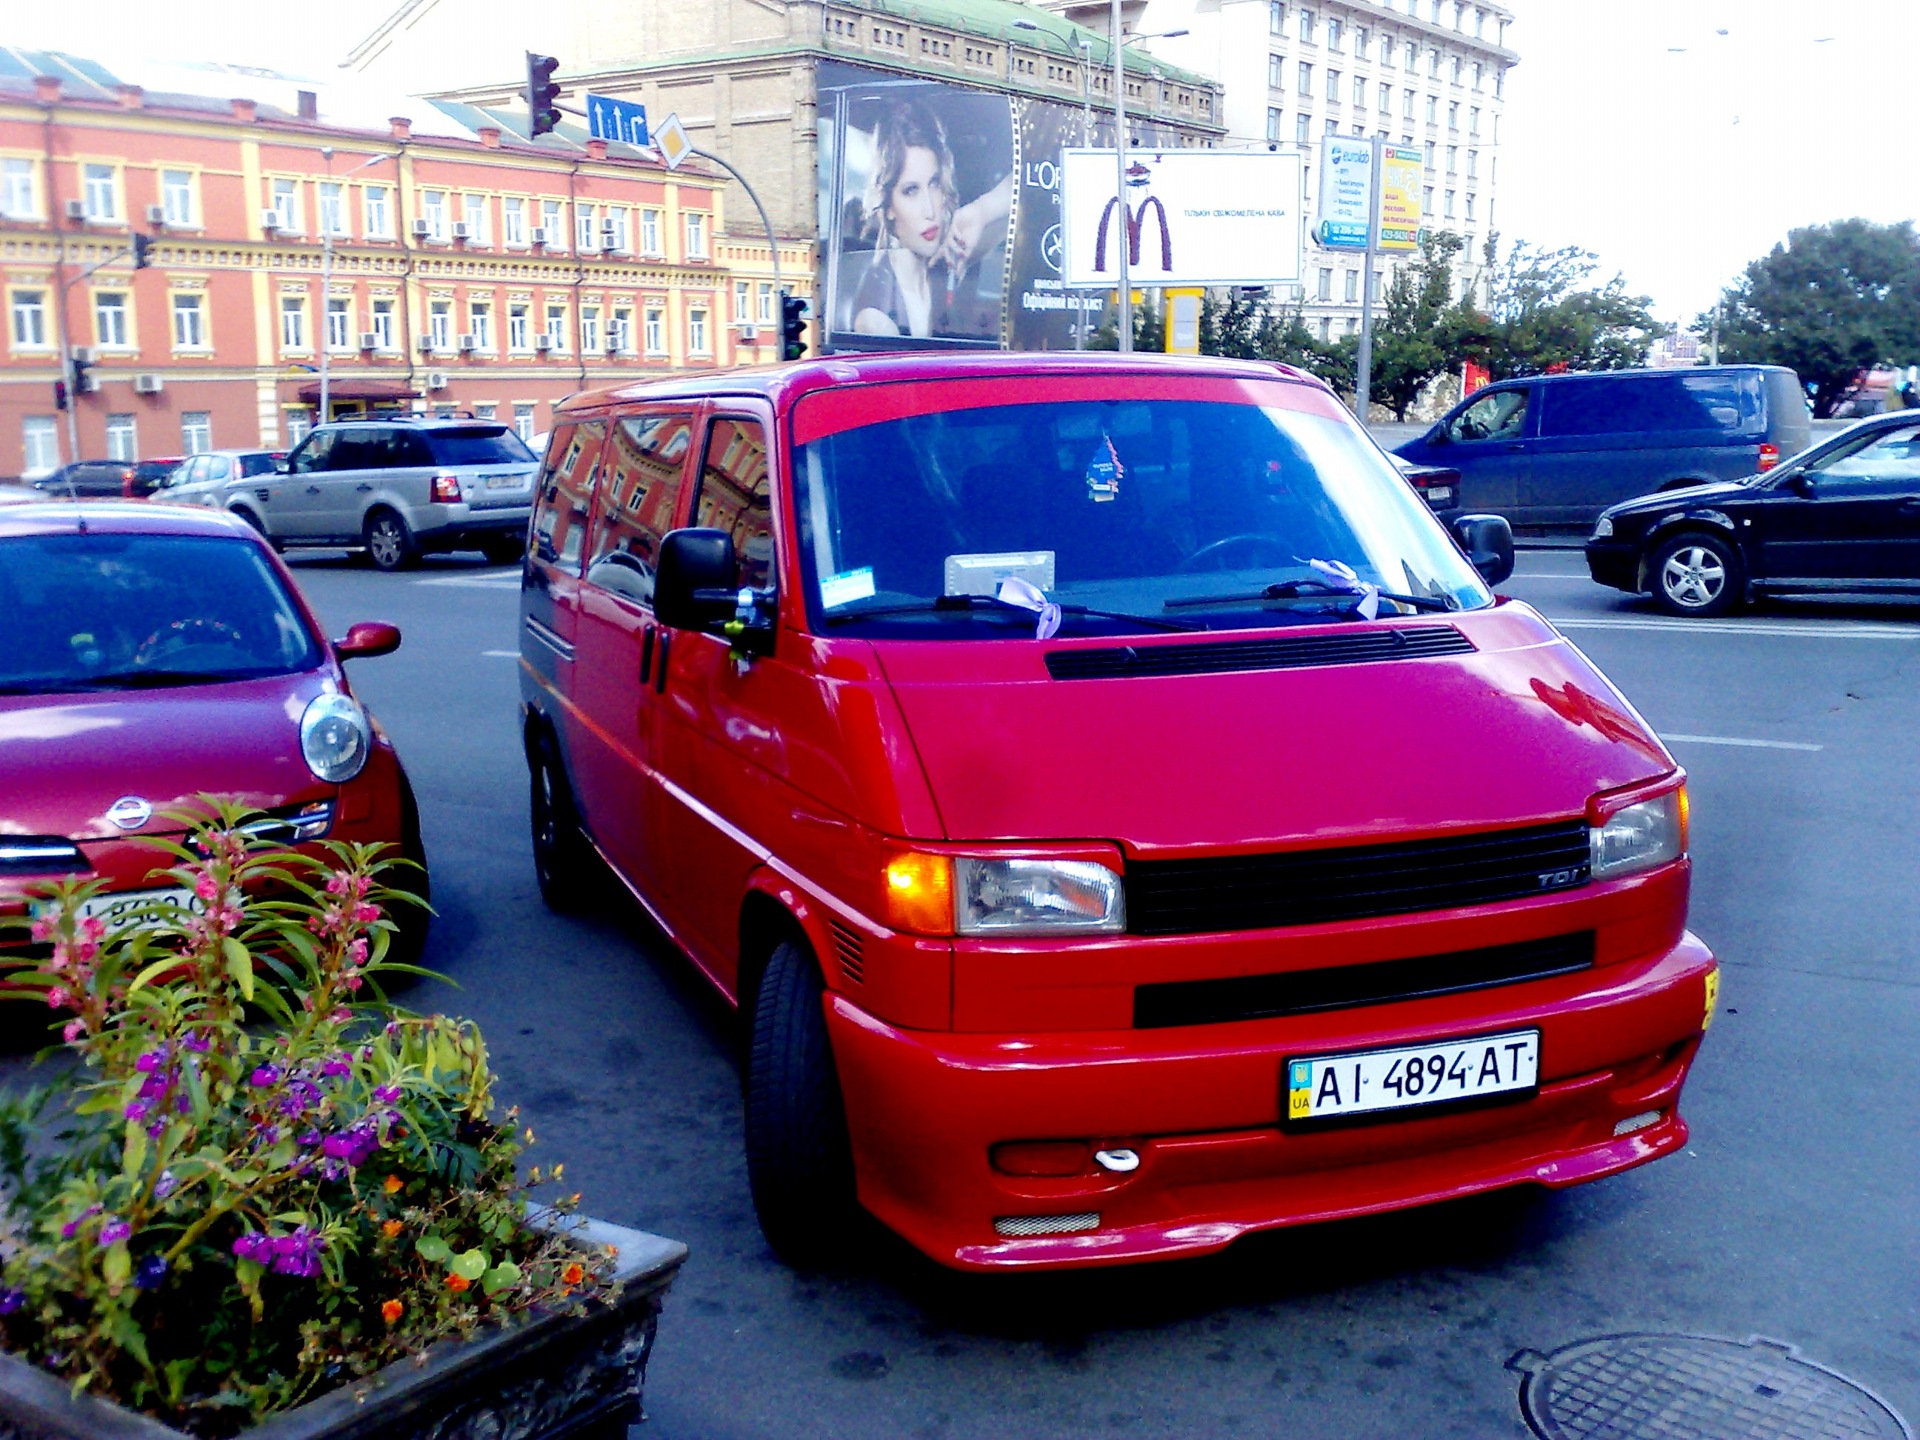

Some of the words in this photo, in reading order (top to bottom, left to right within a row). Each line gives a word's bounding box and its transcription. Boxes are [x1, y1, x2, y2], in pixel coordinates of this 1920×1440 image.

[1343, 150, 1369, 163] eurolab
[1267, 209, 1286, 217] КАВА
[1067, 294, 1103, 311] візжист
[1538, 869, 1579, 886] TDI
[1315, 1063, 1361, 1108] AI
[1383, 1050, 1467, 1098] 4894
[1477, 1042, 1528, 1087] AT
[1293, 1097, 1310, 1110] UA
